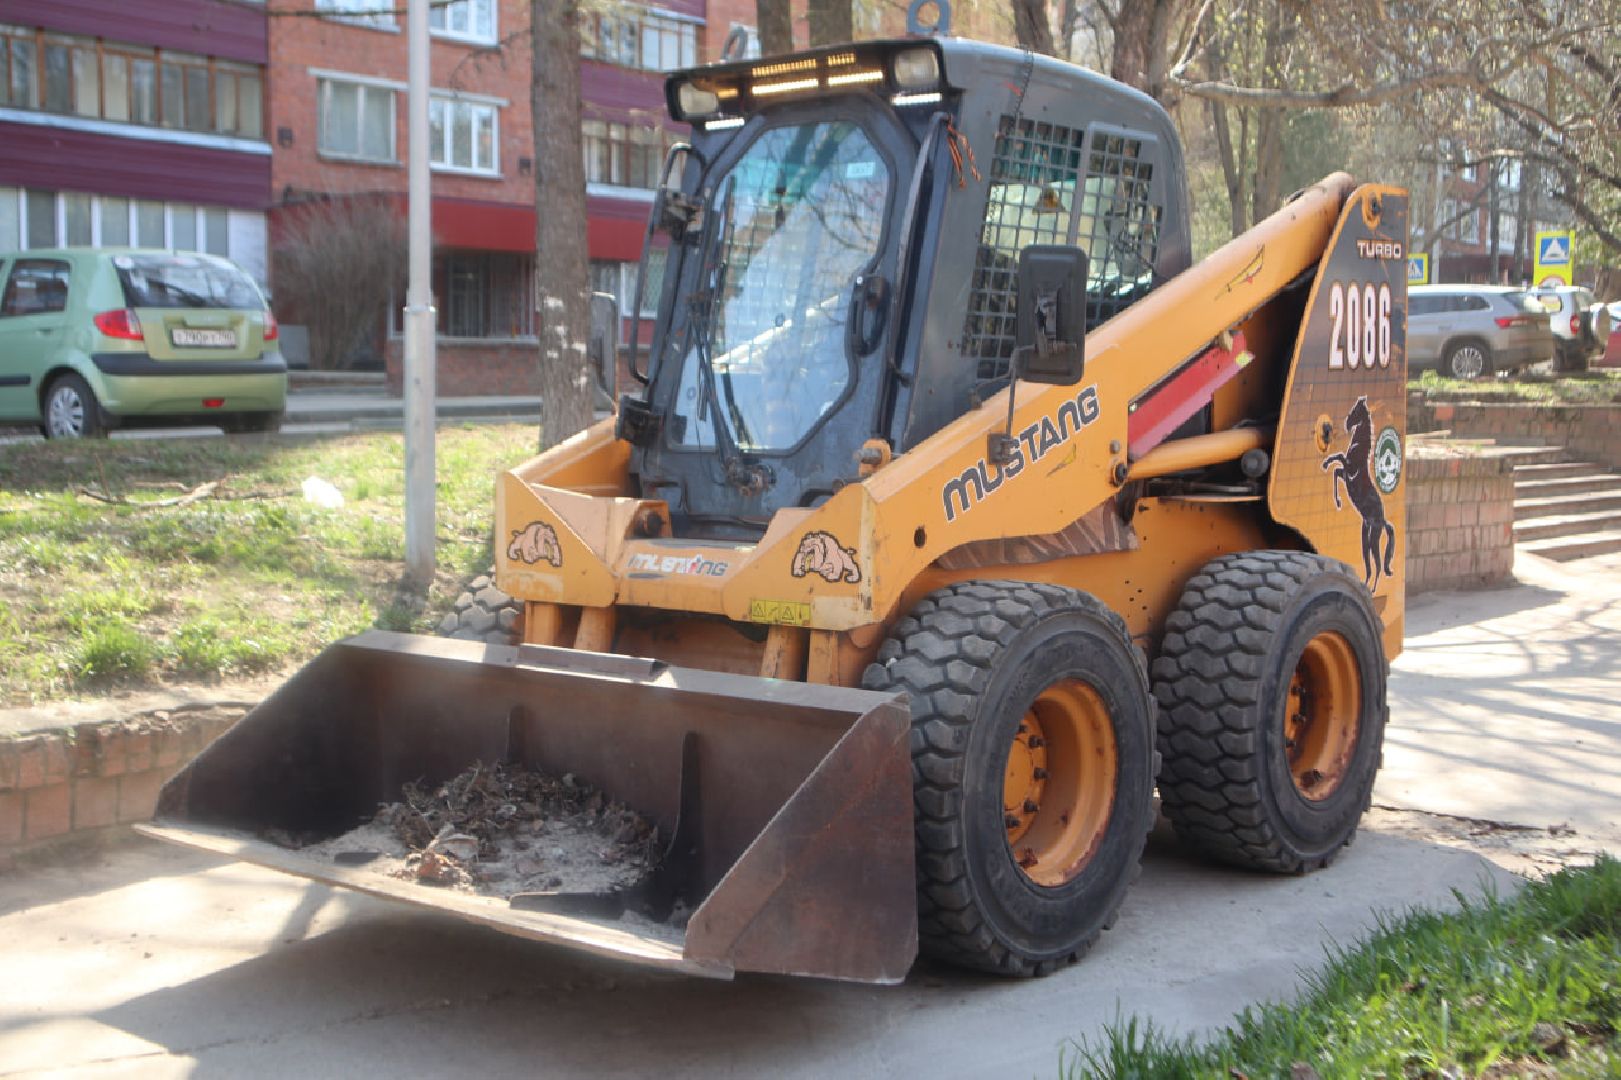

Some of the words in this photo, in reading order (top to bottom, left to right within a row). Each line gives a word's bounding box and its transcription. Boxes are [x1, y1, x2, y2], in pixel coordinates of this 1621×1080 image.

[1357, 240, 1402, 259] TURBO
[1329, 281, 1391, 369] 2086
[943, 385, 1100, 522] MUSTANG
